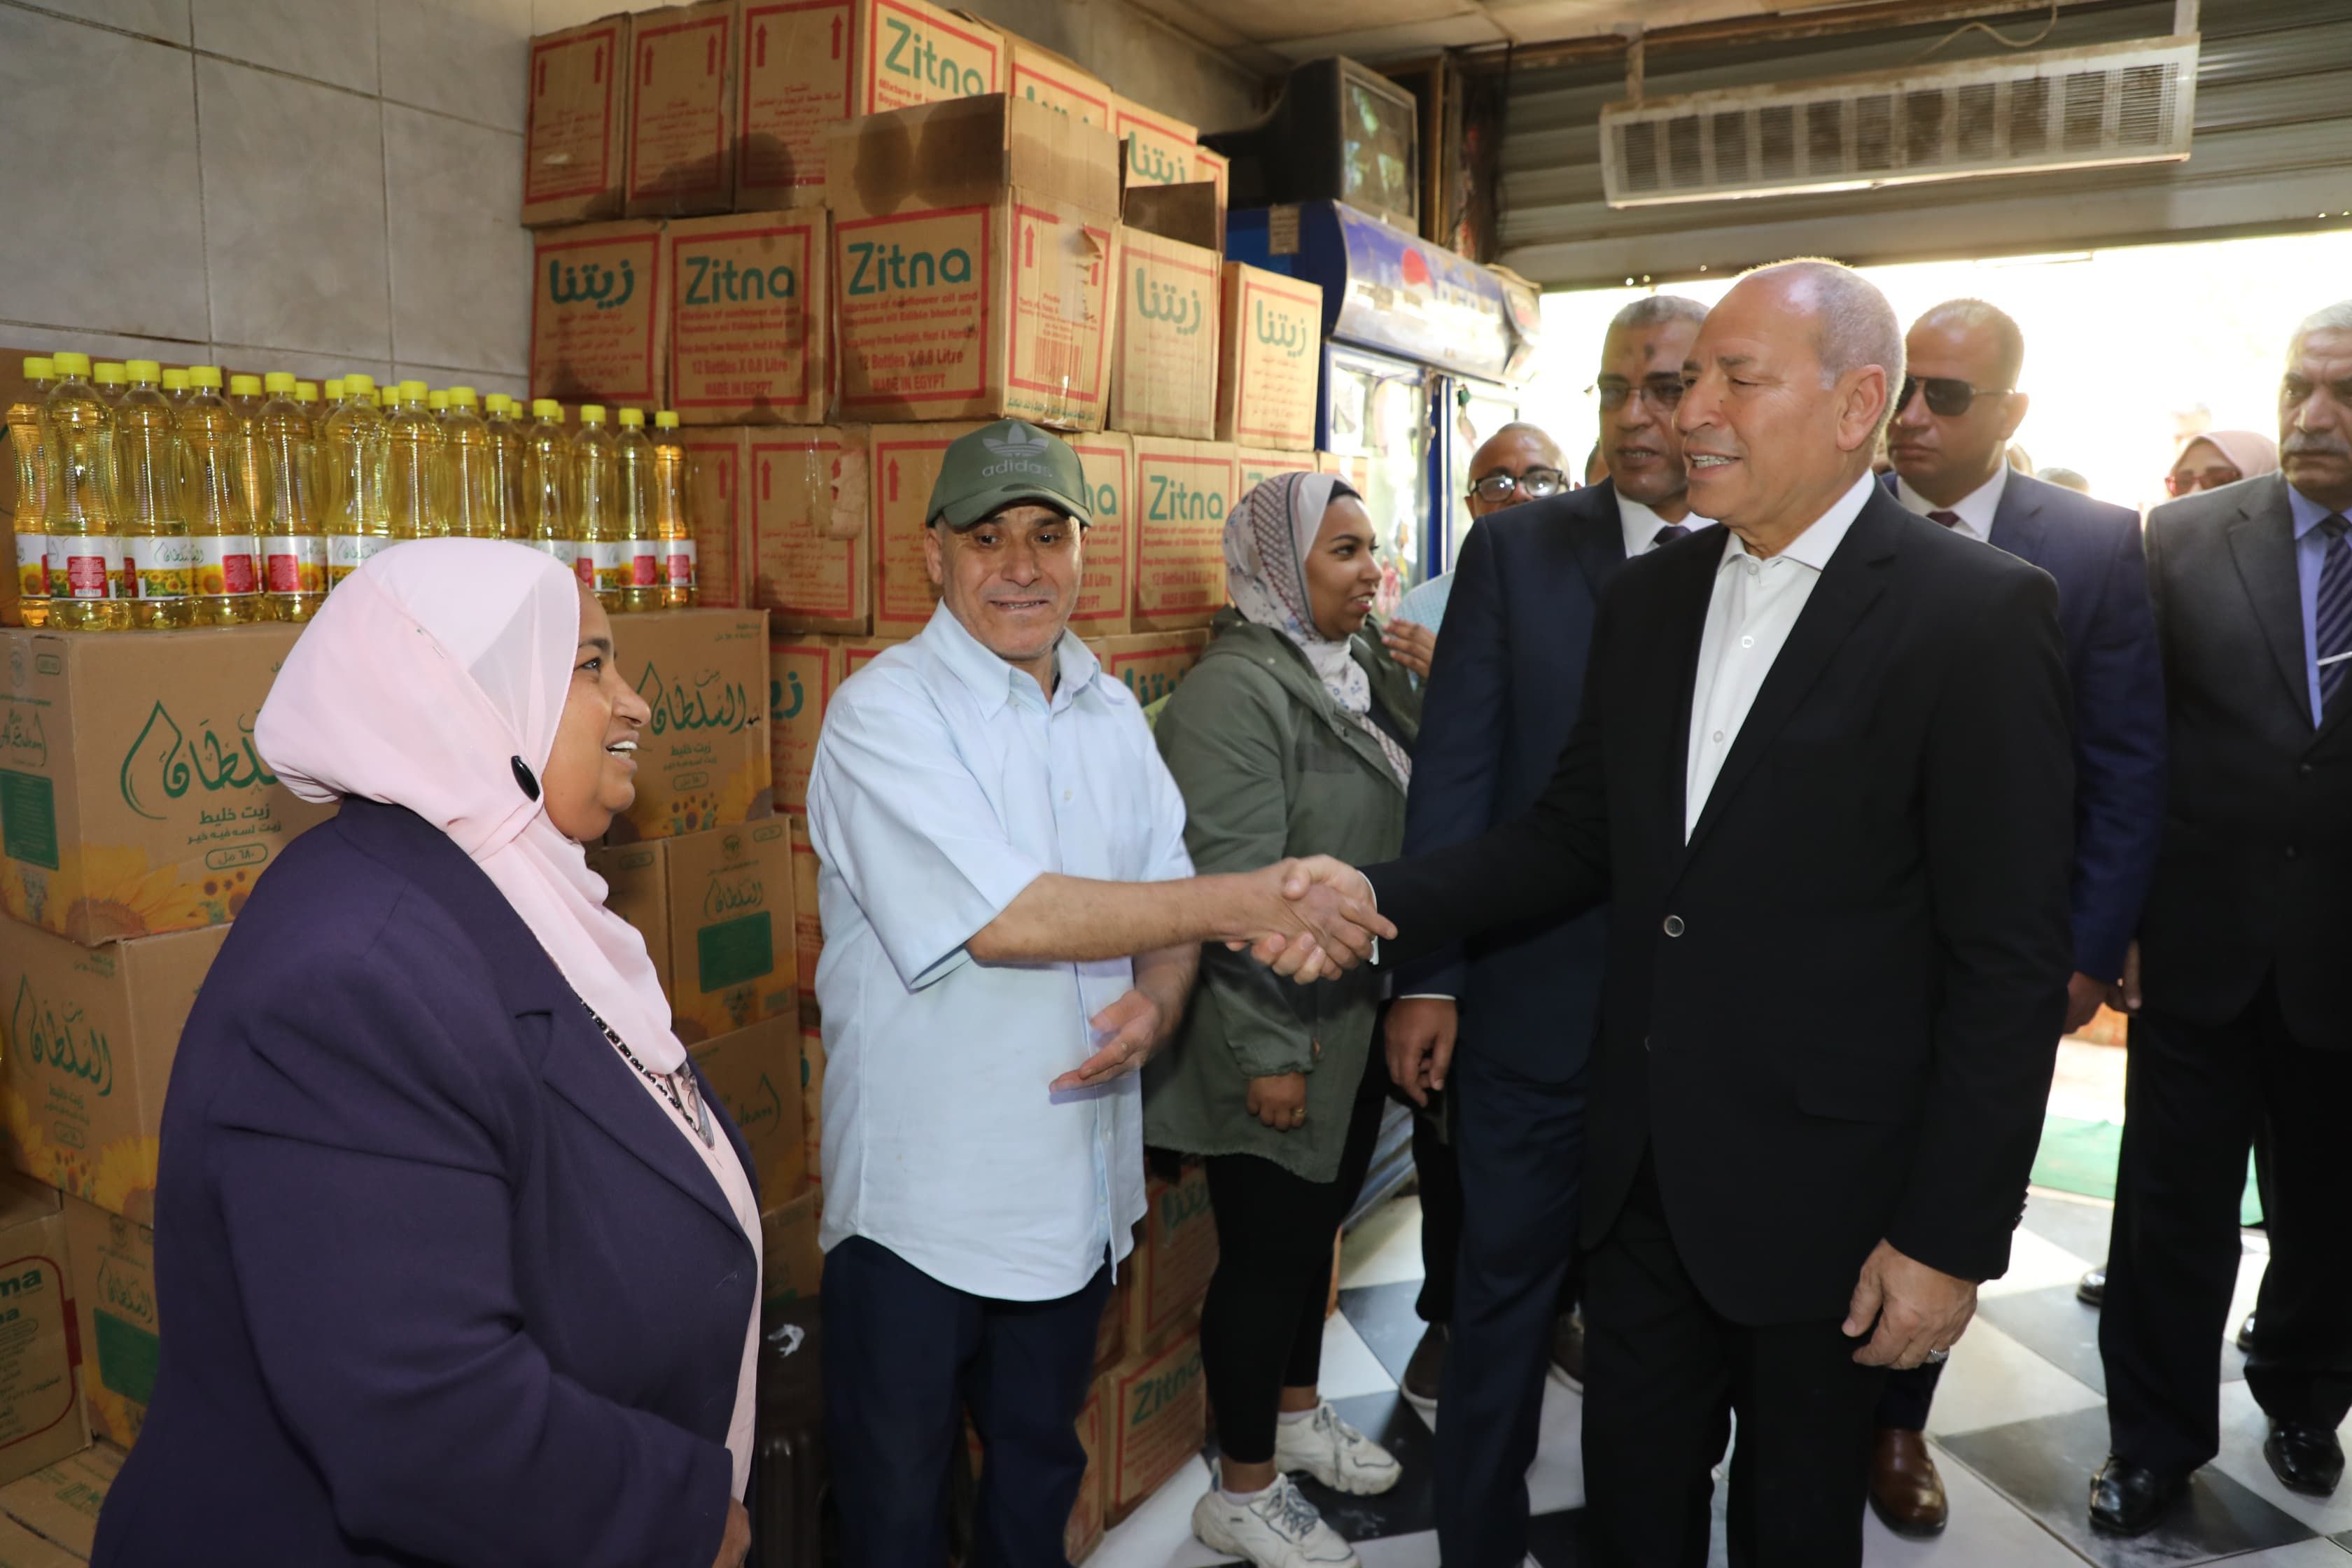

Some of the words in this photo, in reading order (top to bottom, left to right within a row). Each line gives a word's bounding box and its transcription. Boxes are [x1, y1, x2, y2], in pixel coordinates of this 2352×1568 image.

[885, 17, 984, 98] Zitna
[550, 259, 636, 310] زيتنا
[685, 255, 796, 306] Zitna
[848, 241, 972, 296] Zitna
[1135, 267, 1202, 336] زيتنا
[1256, 299, 1307, 358] زيتنا
[913, 372, 946, 389] EGYPT
[937, 348, 964, 365] Litre
[982, 459, 1052, 477] adidas
[1149, 475, 1224, 521] Zitna
[199, 807, 237, 827] خليط
[241, 804, 270, 821] زيت
